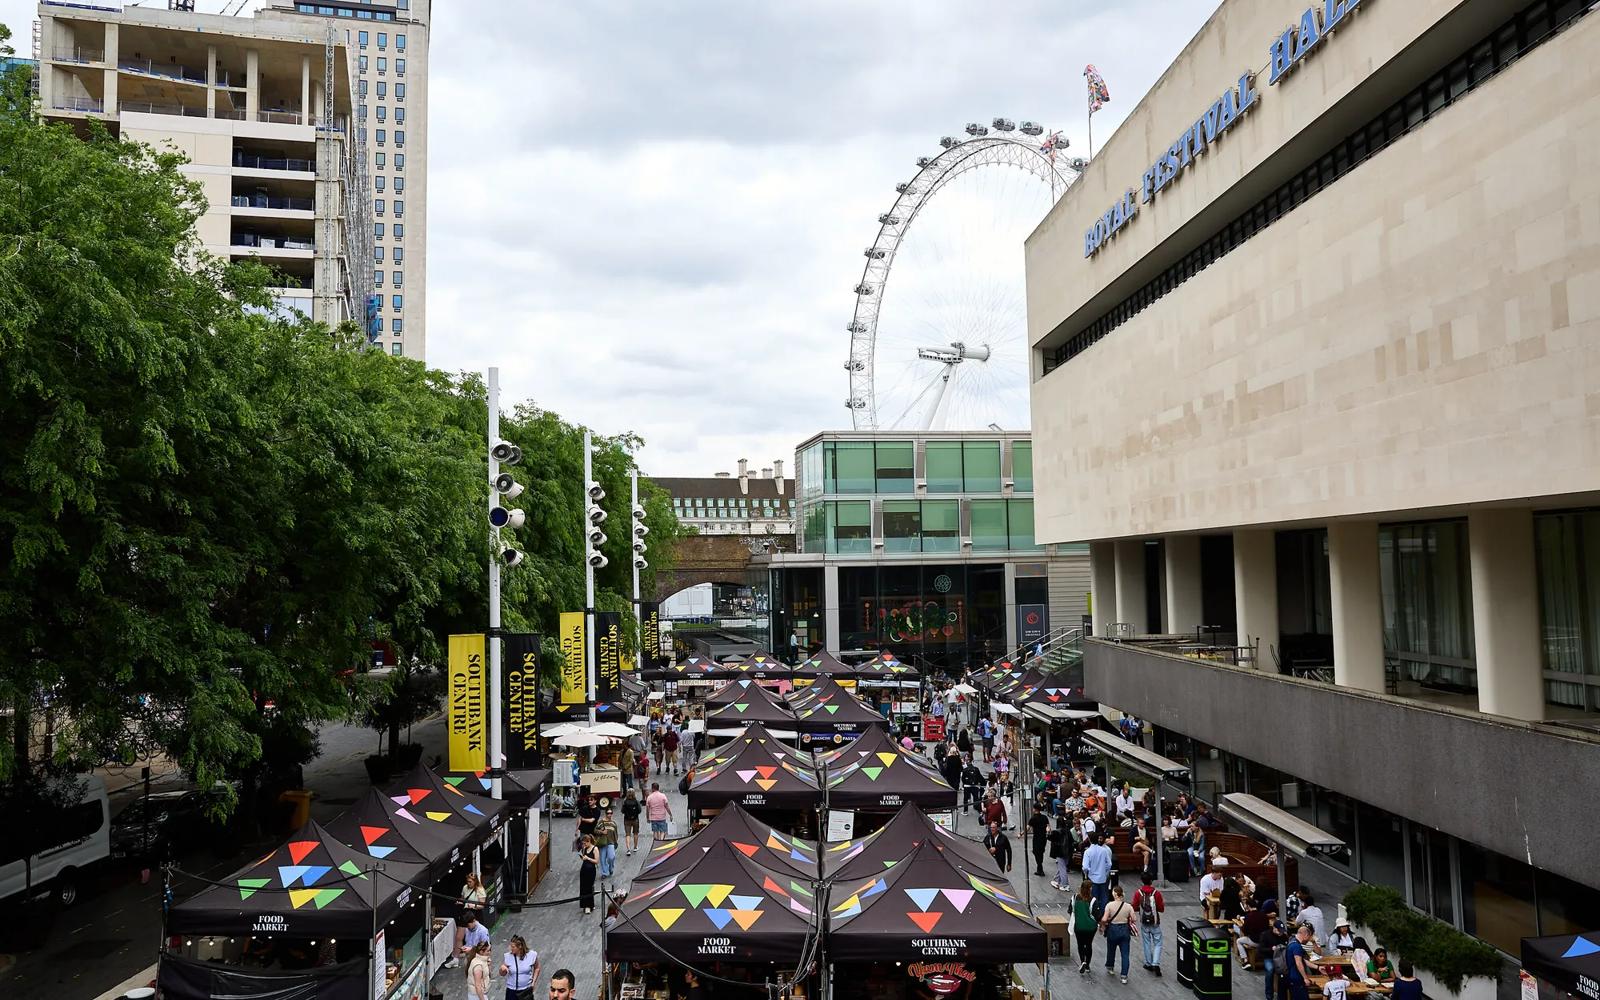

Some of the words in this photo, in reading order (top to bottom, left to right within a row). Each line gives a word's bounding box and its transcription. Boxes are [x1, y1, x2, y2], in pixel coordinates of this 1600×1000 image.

[1084, 189, 1138, 258] ROYAL
[1142, 72, 1259, 205] FESTIVAL
[608, 624, 619, 689] SOUTHBANK
[650, 611, 659, 660] SOUTHBANK
[573, 625, 583, 690] SOUTHBANK
[600, 636, 609, 678] CENTRE
[454, 673, 467, 735] CENTRE
[468, 654, 481, 751] SOUTHBANK
[509, 671, 522, 733] CENTRE
[523, 652, 537, 750] SOUTHBANK
[252, 923, 290, 932] MARKET
[259, 915, 284, 923] FOOD
[697, 945, 737, 954] MARKET
[703, 937, 731, 946] FOOD
[911, 938, 967, 948] SOUTHBANK
[921, 947, 958, 956] CENTRE
[1576, 982, 1600, 1000] MARKE
[1579, 974, 1599, 991] FOOD
